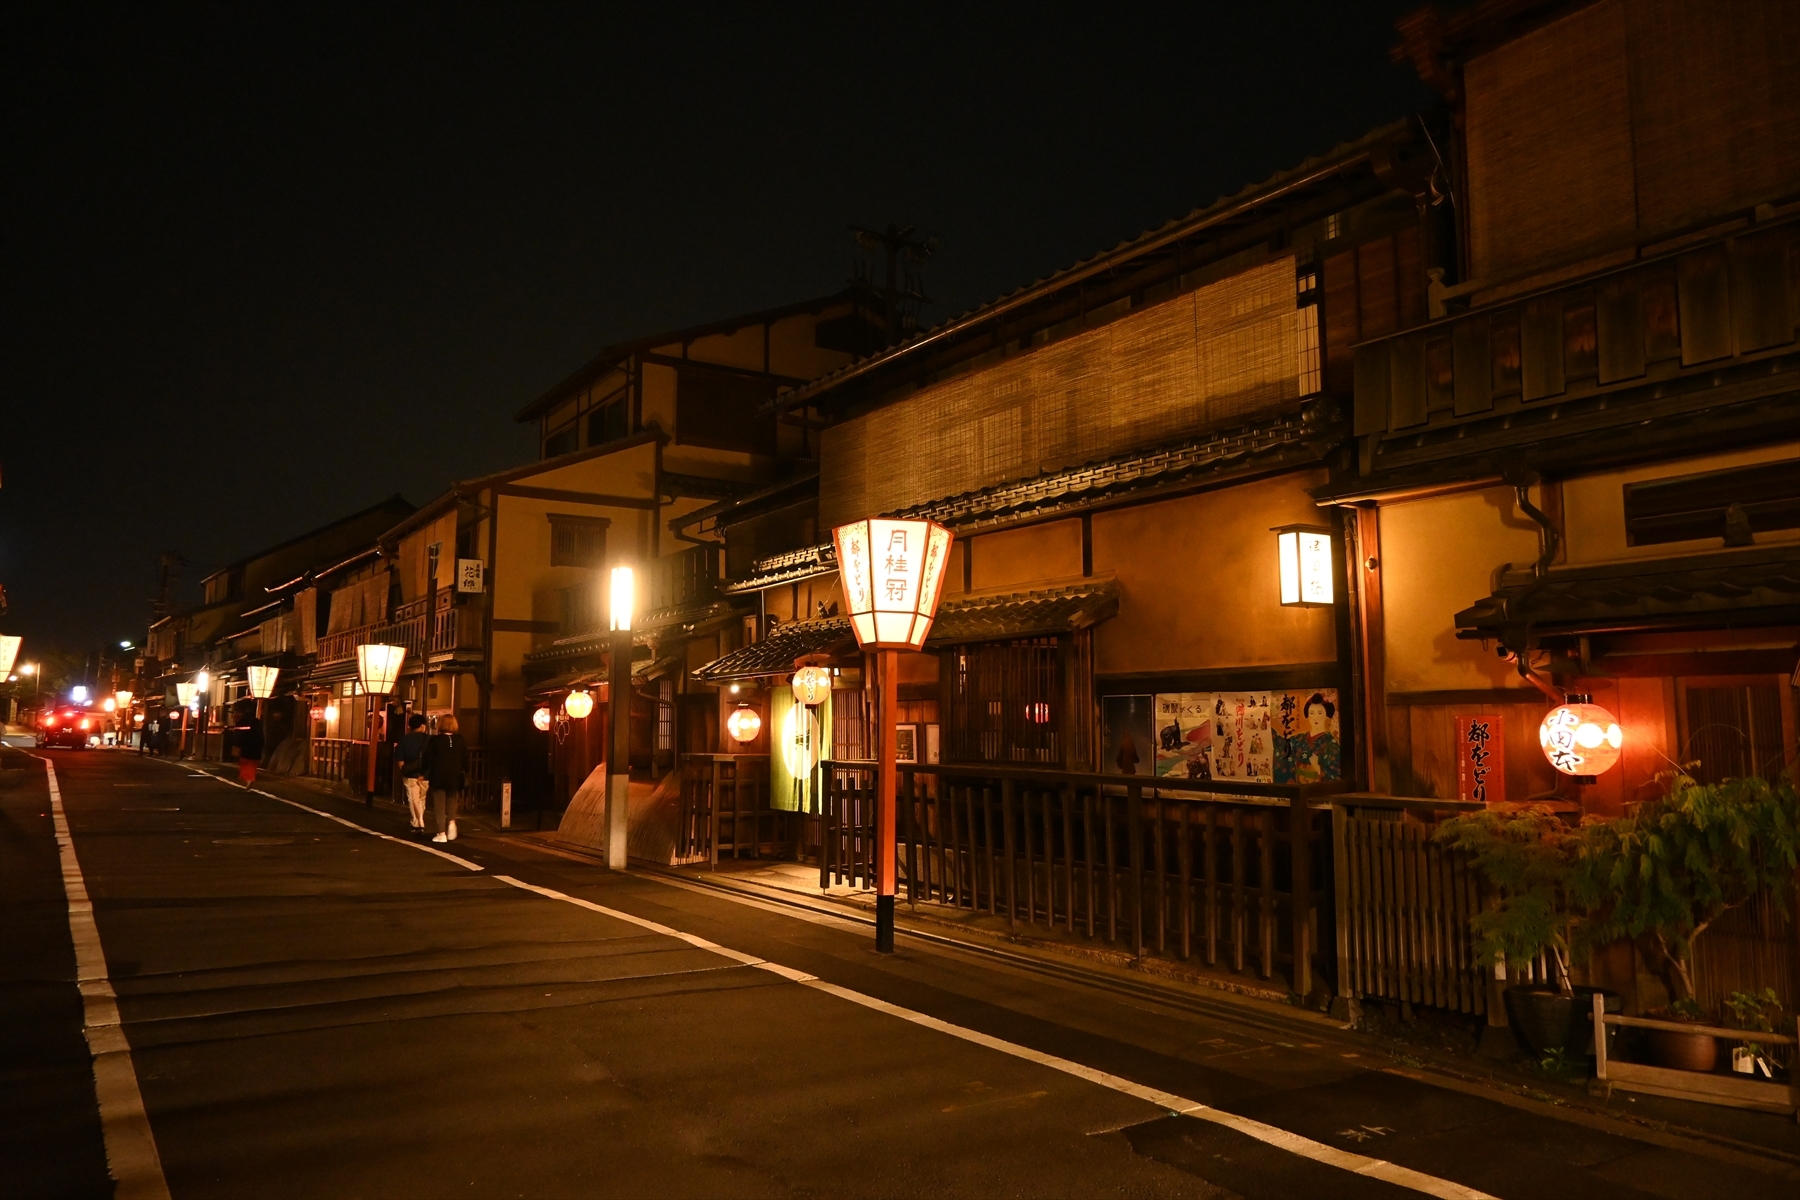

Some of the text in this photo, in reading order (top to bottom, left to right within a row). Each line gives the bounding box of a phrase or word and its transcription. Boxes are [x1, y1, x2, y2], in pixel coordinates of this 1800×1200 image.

[884, 529, 909, 601] 月桂冠
[1280, 693, 1296, 760] 都をどり
[1467, 718, 1491, 801] 都をどり
[1549, 710, 1580, 771] 小田本
